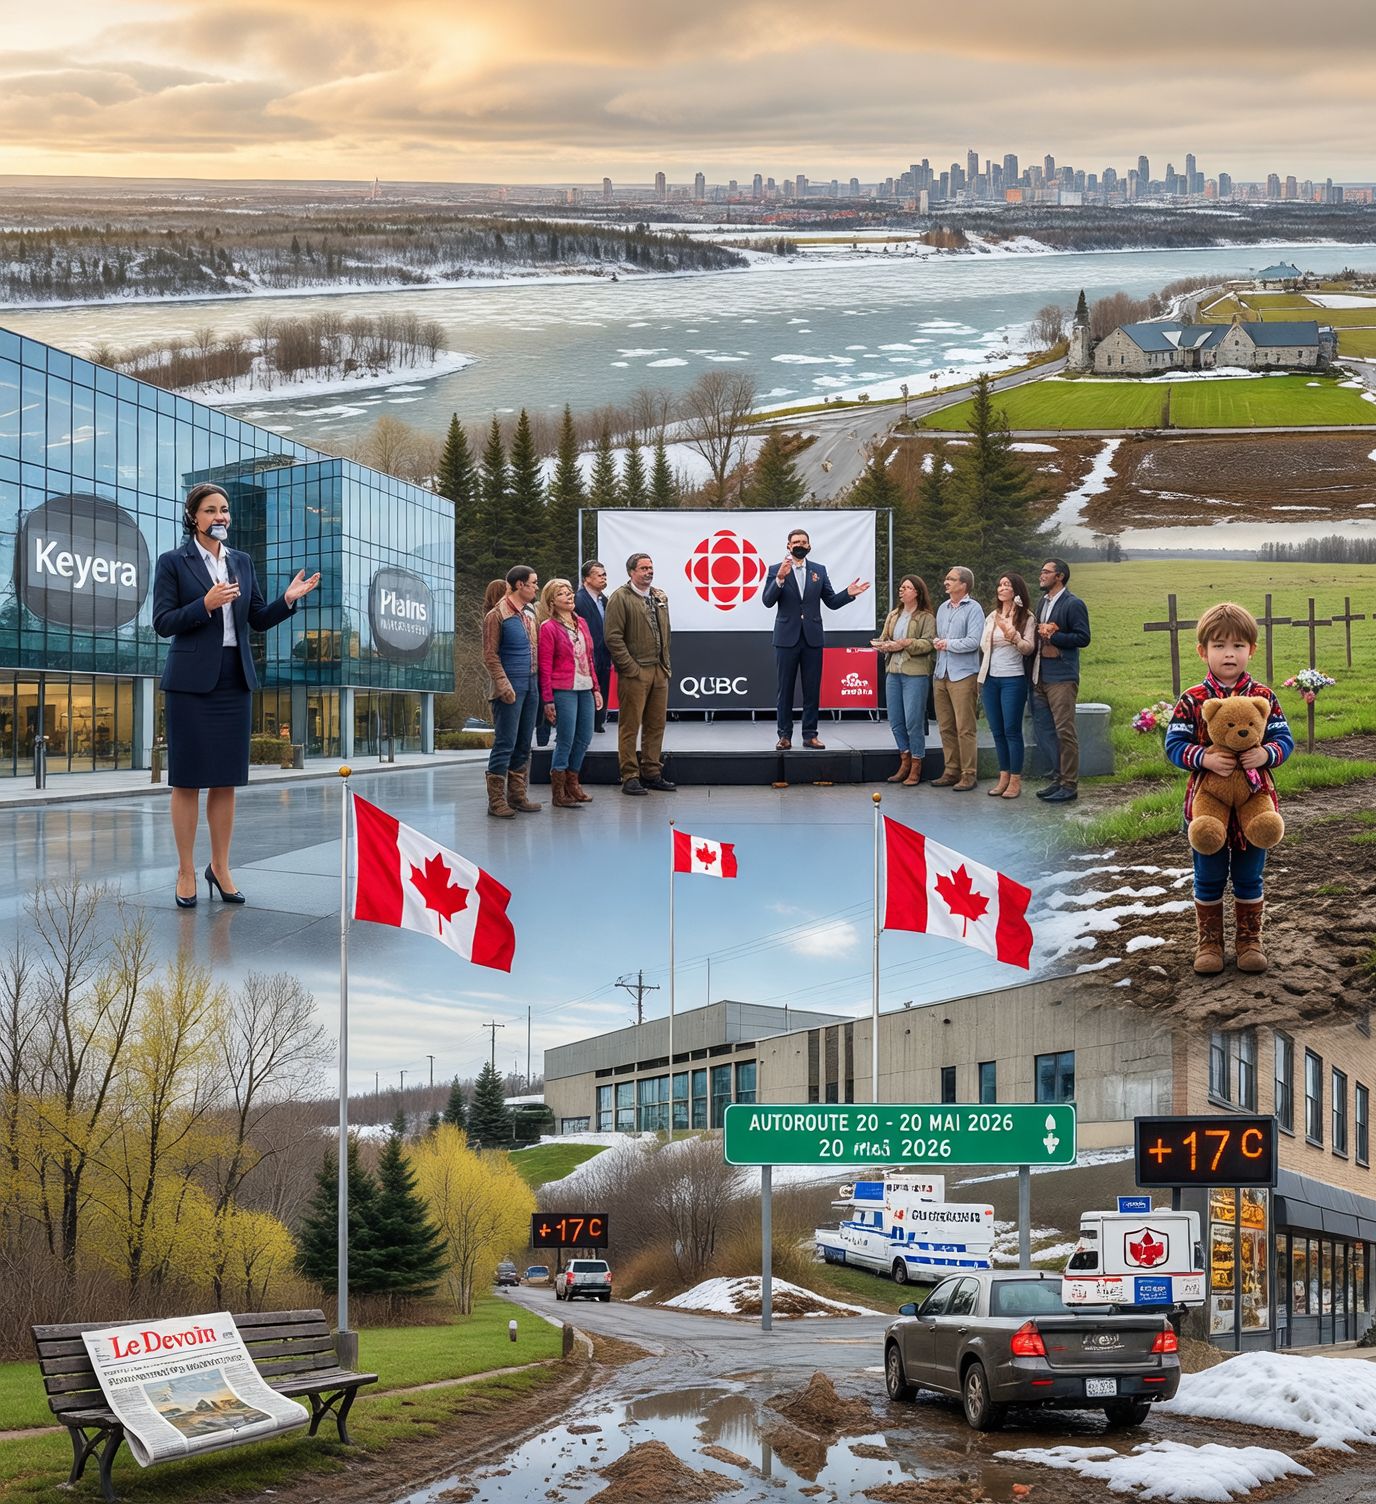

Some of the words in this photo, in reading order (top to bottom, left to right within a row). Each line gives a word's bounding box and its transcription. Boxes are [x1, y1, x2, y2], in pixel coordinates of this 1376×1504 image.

[36, 538, 137, 588] Keyera
[381, 588, 427, 621] Plains
[749, 1113, 849, 1131] AUTOROUTE
[856, 1114, 878, 1132] 20
[899, 1113, 922, 1131] 20
[929, 1113, 960, 1131] MAI
[968, 1113, 1013, 1131] 2026
[819, 1138, 844, 1157] 20
[901, 1139, 951, 1157] 2026
[108, 1335, 141, 1360] Le
